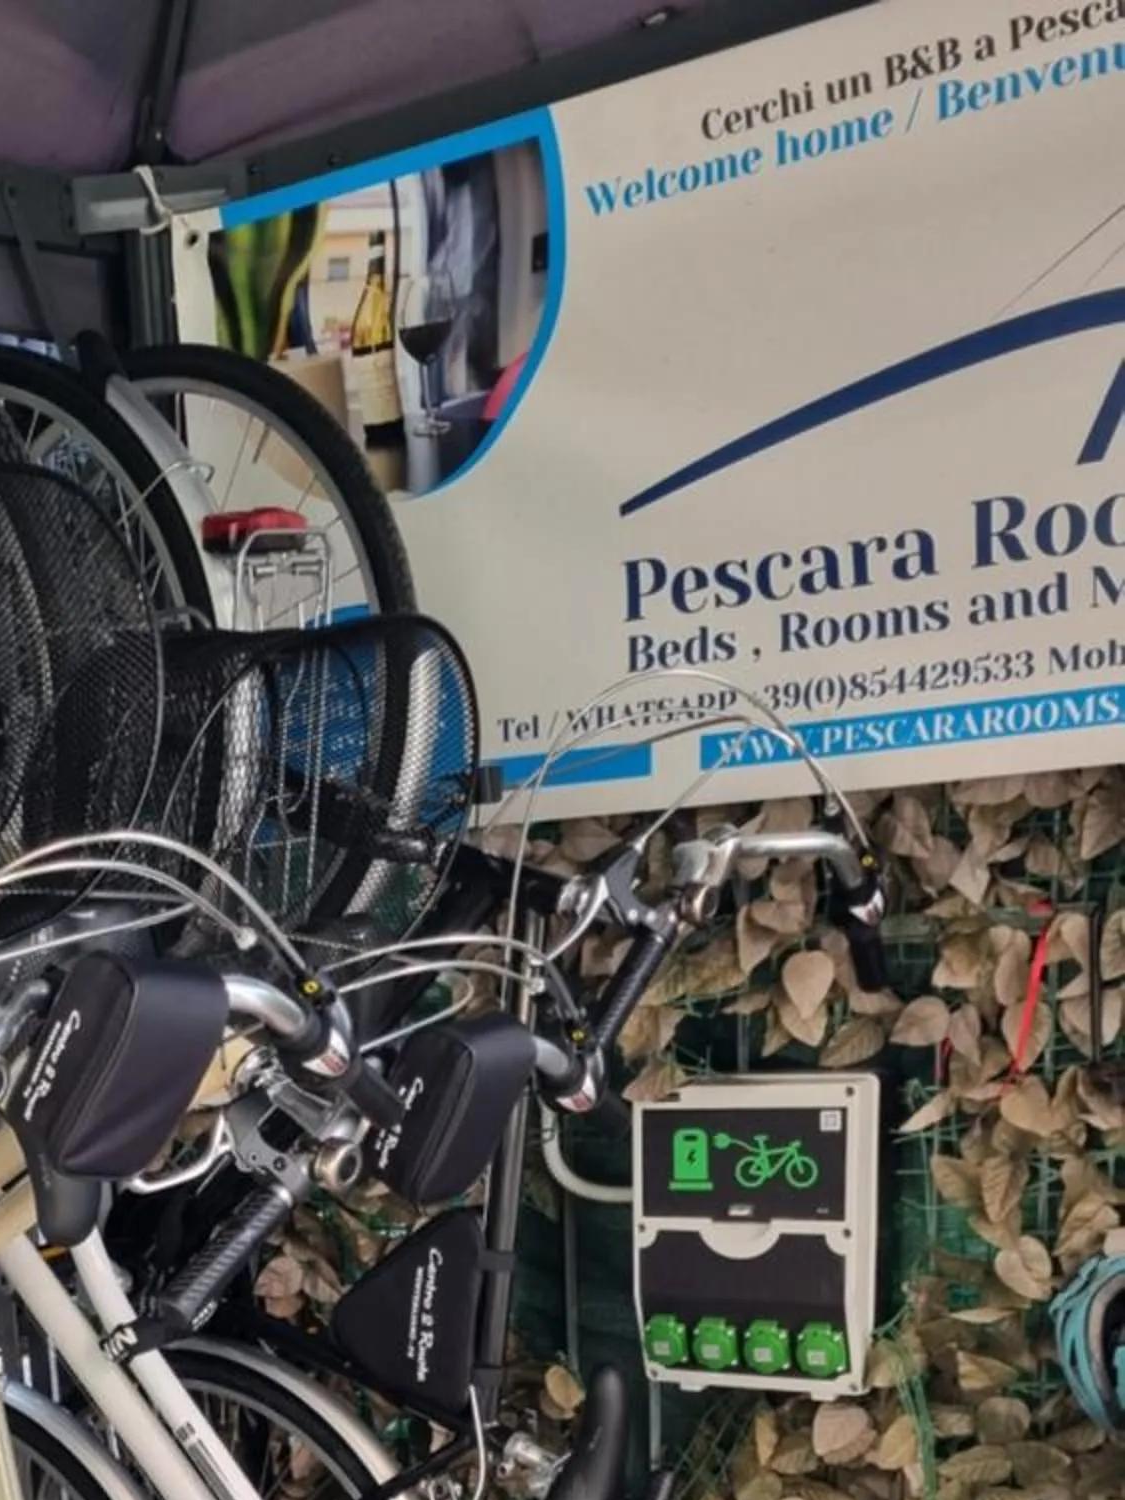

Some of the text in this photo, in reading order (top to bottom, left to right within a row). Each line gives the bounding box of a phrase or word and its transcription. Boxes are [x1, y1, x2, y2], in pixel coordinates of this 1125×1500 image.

[701, 81, 815, 141] Cerchi
[825, 70, 873, 105] un
[884, 37, 962, 89] B&B
[974, 34, 996, 61] a
[585, 146, 762, 217] Welcome
[775, 107, 893, 166] home
[905, 87, 923, 133] /
[622, 528, 939, 622] Pescara
[627, 626, 737, 673] Beds
[780, 598, 951, 652] Rooms
[968, 571, 1069, 626] and
[497, 714, 539, 743] Tel
[422, 1246, 444, 1310] Centro
